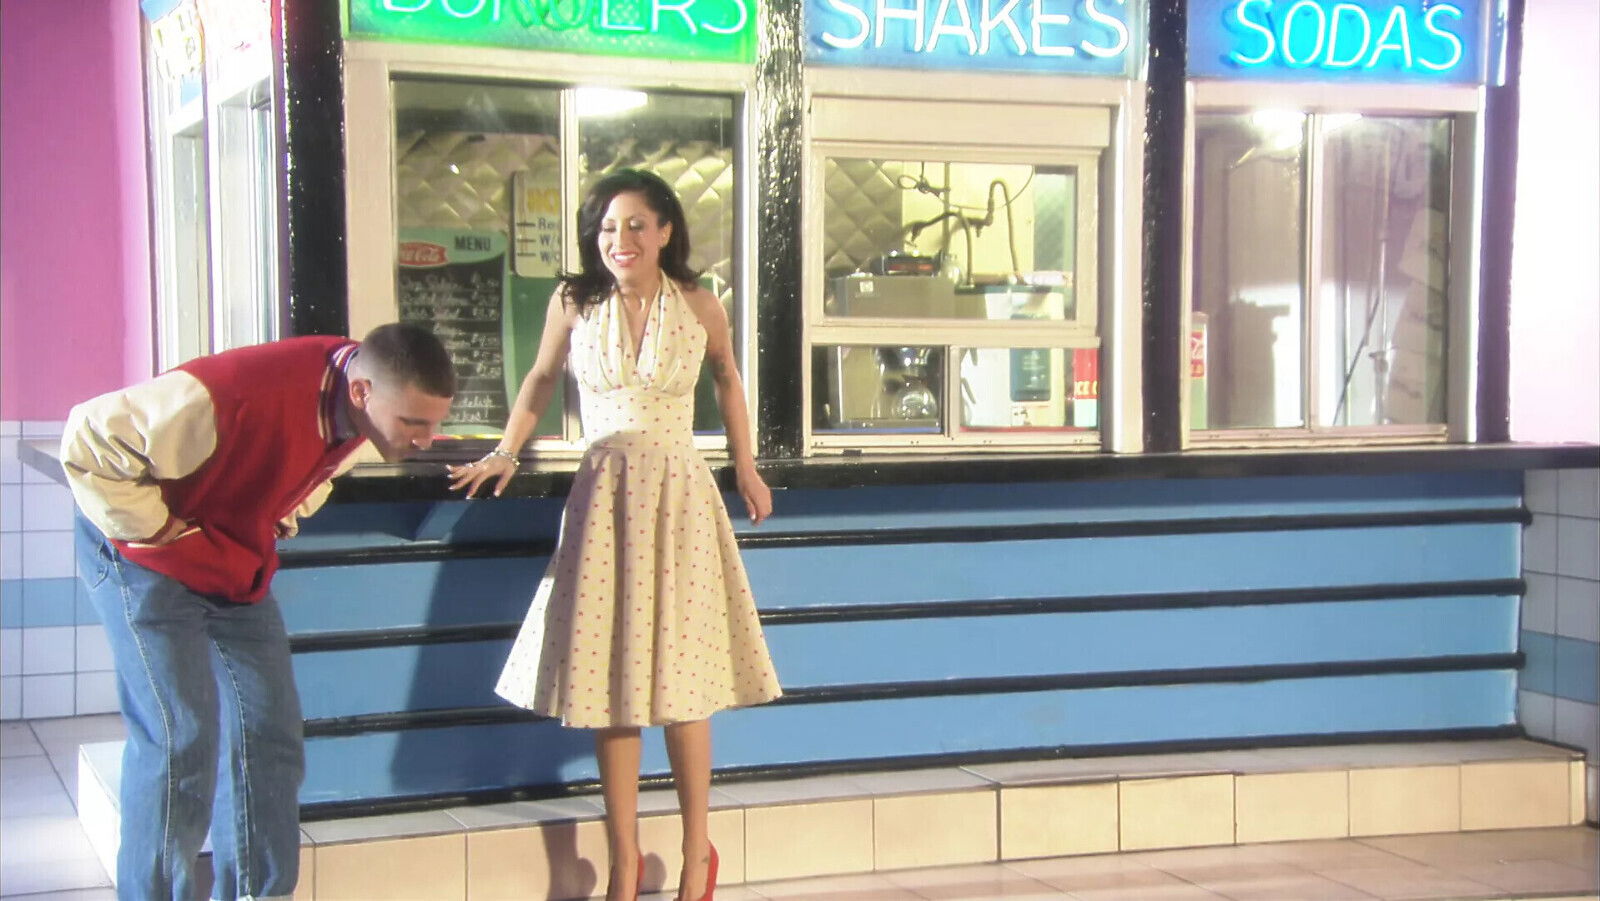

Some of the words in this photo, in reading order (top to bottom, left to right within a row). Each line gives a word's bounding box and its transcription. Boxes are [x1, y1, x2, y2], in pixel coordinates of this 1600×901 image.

[822, 0, 1128, 57] SHAKES
[1231, 0, 1462, 70] SODAS
[454, 235, 491, 251] MENU
